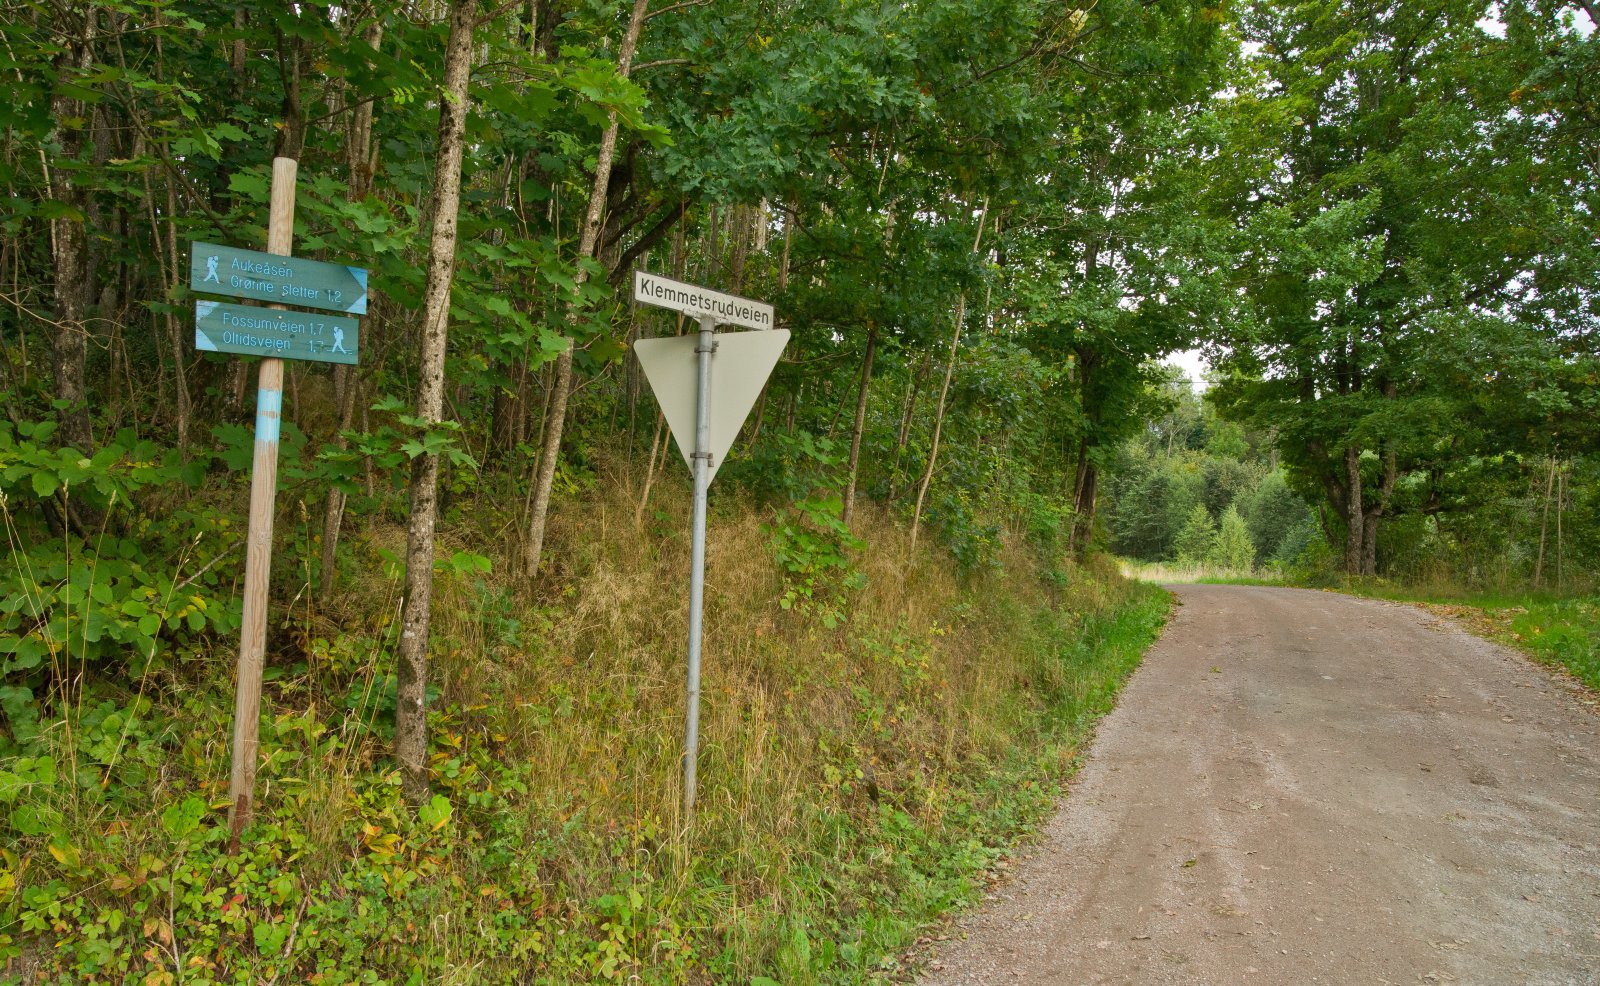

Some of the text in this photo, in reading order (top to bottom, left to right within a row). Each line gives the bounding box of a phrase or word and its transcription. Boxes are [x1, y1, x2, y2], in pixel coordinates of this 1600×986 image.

[231, 257, 293, 277] Aukeåsen
[231, 275, 274, 293] Grønne
[282, 285, 319, 299] sletter
[641, 278, 769, 324] Klemmetsrudveien
[223, 312, 305, 334] Fossumveien
